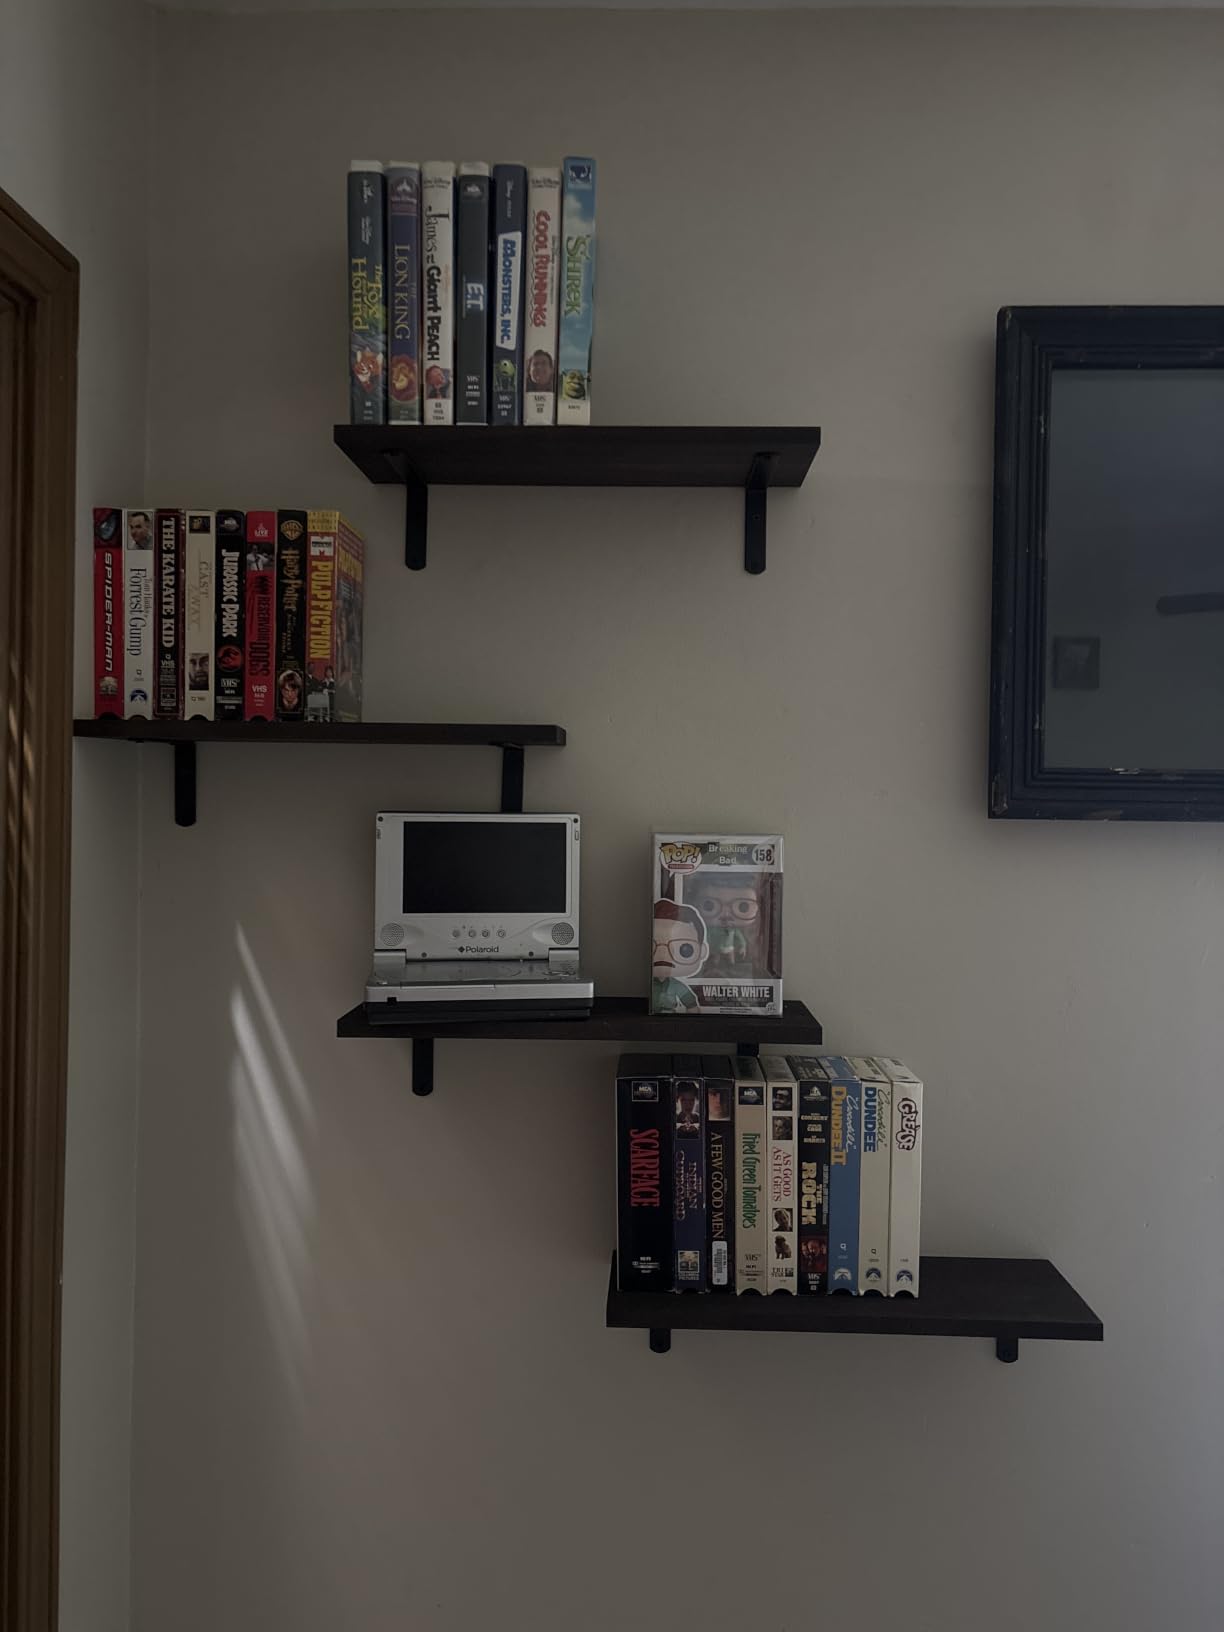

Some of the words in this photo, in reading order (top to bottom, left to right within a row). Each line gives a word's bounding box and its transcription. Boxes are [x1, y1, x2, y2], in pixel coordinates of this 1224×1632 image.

[424, 205, 450, 252] James
[535, 209, 551, 252] COOL
[374, 263, 383, 282] The
[394, 243, 411, 288] LION
[500, 238, 516, 317] MONSTERS,
[351, 256, 369, 331] Hound
[364, 281, 383, 319] Fox
[426, 265, 442, 313] Giant
[466, 282, 484, 311] E.T.
[533, 254, 550, 328] RUNNINGS
[394, 292, 411, 340] KING
[500, 319, 512, 344] INC.
[426, 315, 442, 361] PEACH
[162, 517, 175, 550] THE
[221, 548, 241, 603] JURASSIC
[280, 547, 302, 578] Harry
[311, 560, 333, 599] PULP
[129, 567, 147, 617] Forrest
[162, 552, 176, 616] KARATE
[280, 577, 304, 612] Potter
[104, 551, 113, 673] SPIDER-MAN
[220, 603, 240, 638] PARK
[257, 596, 271, 641] RESERVOIR
[310, 599, 333, 658] FICTION
[126, 617, 147, 656] Gump
[161, 618, 175, 648] KID
[248, 641, 271, 677] DOGS
[252, 685, 268, 693] VHS
[660, 842, 701, 864] POP!
[708, 843, 748, 855] Breaking
[719, 855, 737, 865] Bad
[754, 849, 772, 863] 158
[465, 945, 499, 953] Polaroid
[702, 985, 739, 998] WALTER
[742, 986, 771, 998] WHITE
[831, 1086, 846, 1150] DUNDEE
[863, 1086, 877, 1153] DUNDEE
[896, 1097, 921, 1151] GREASE
[711, 1131, 723, 1141] A
[742, 1132, 760, 1155] Fried
[630, 1128, 661, 1208] SCARFACE
[711, 1143, 723, 1169] FEW
[742, 1156, 760, 1184] Green
[773, 1147, 782, 1161] AS
[773, 1163, 783, 1172] IT
[783, 1152, 792, 1166] AS
[831, 1151, 847, 1166] II
[711, 1170, 724, 1208] GOOD
[773, 1175, 783, 1202] GETS
[783, 1168, 793, 1197] GOOD
[801, 1161, 817, 1225] ROCK
[711, 1210, 724, 1239] MEN
[742, 1185, 761, 1229] Tomatoes
